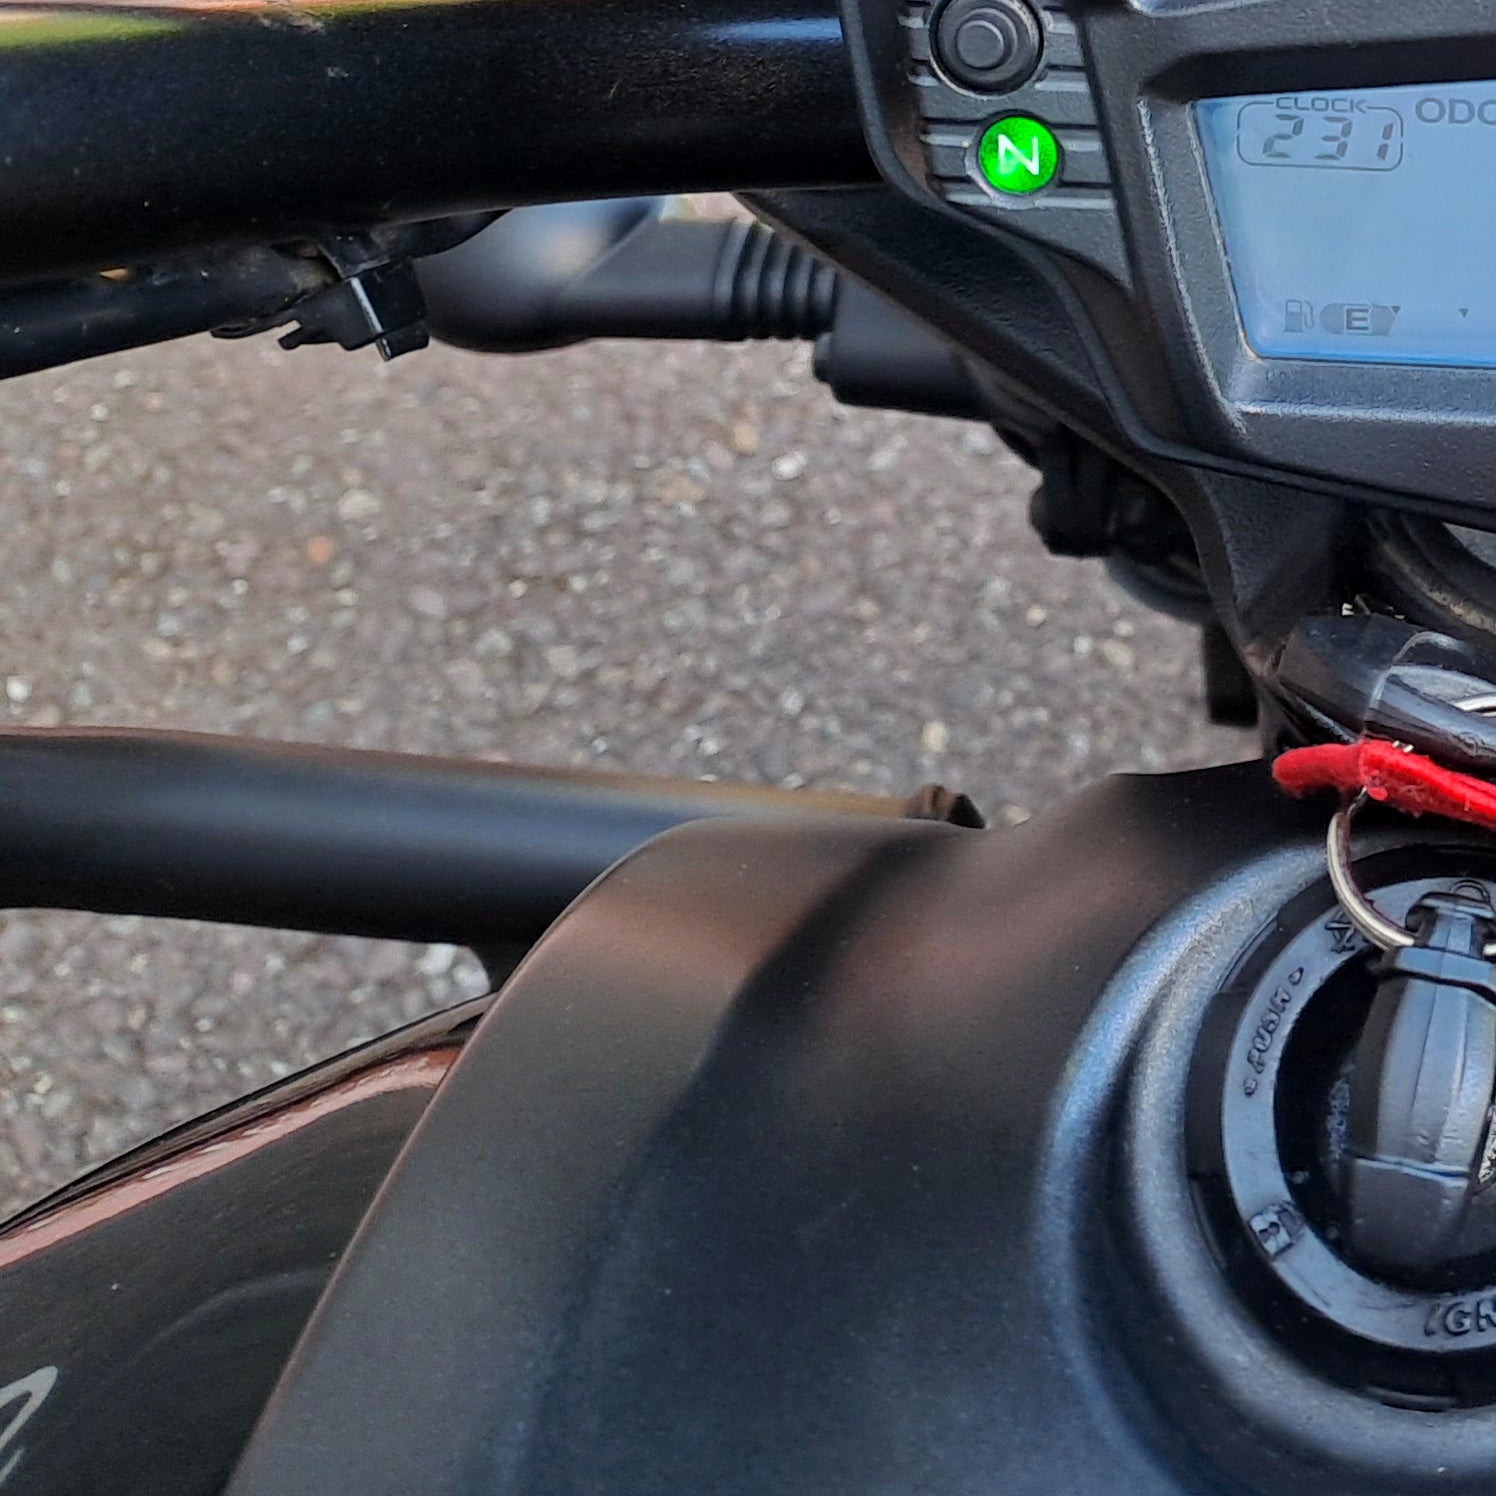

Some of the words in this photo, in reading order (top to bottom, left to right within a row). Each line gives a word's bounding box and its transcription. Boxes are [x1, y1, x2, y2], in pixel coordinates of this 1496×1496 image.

[1275, 96, 1367, 114] CLOCK
[997, 133, 1040, 176] N
[1345, 307, 1370, 331] E
